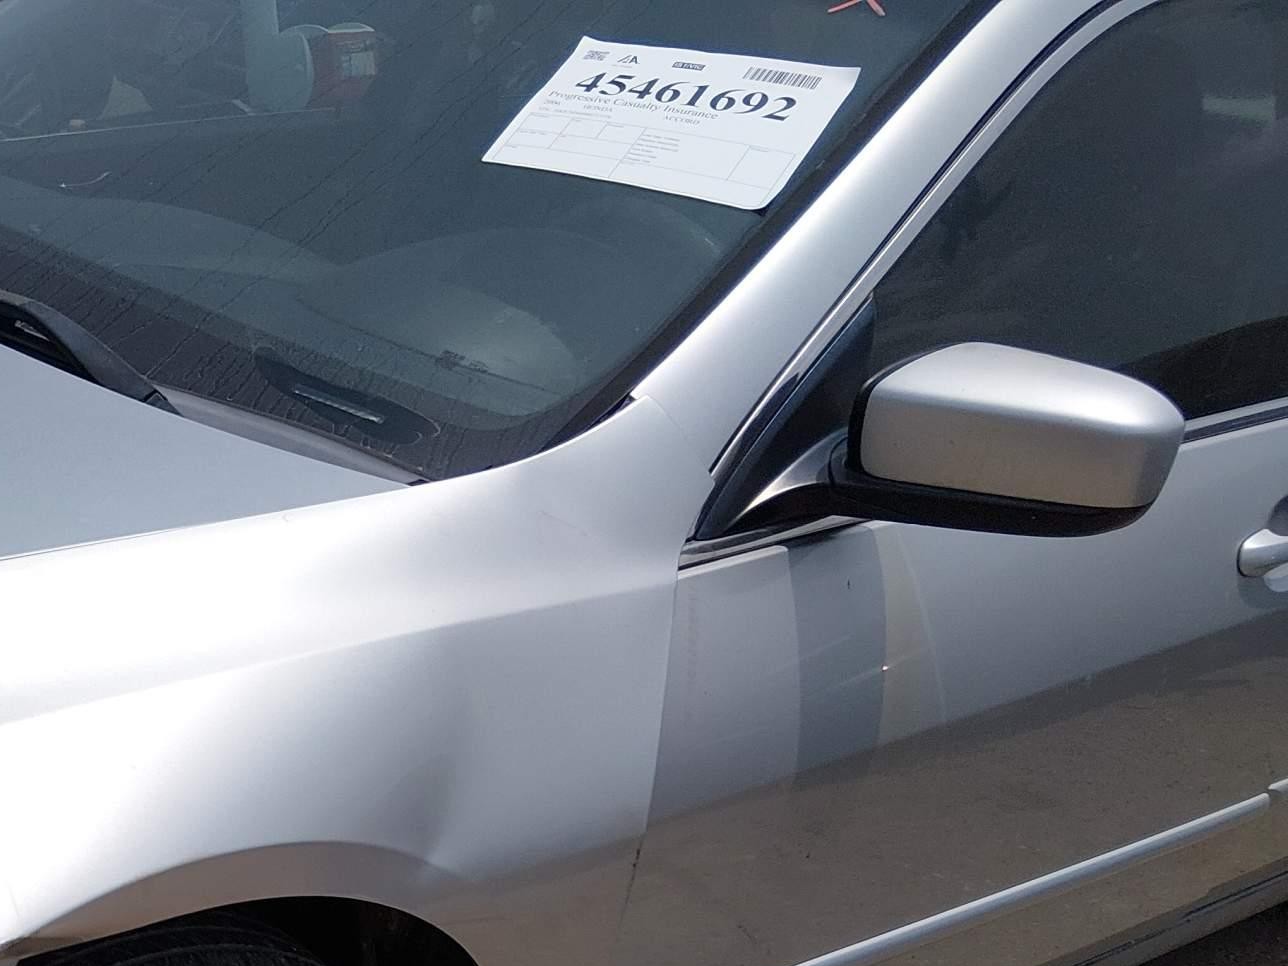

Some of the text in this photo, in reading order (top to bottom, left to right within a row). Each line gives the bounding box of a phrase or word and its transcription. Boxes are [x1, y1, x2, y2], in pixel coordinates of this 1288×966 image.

[548, 90, 719, 120] Progressive Casualty Insurance
[575, 72, 797, 121] 45461692
